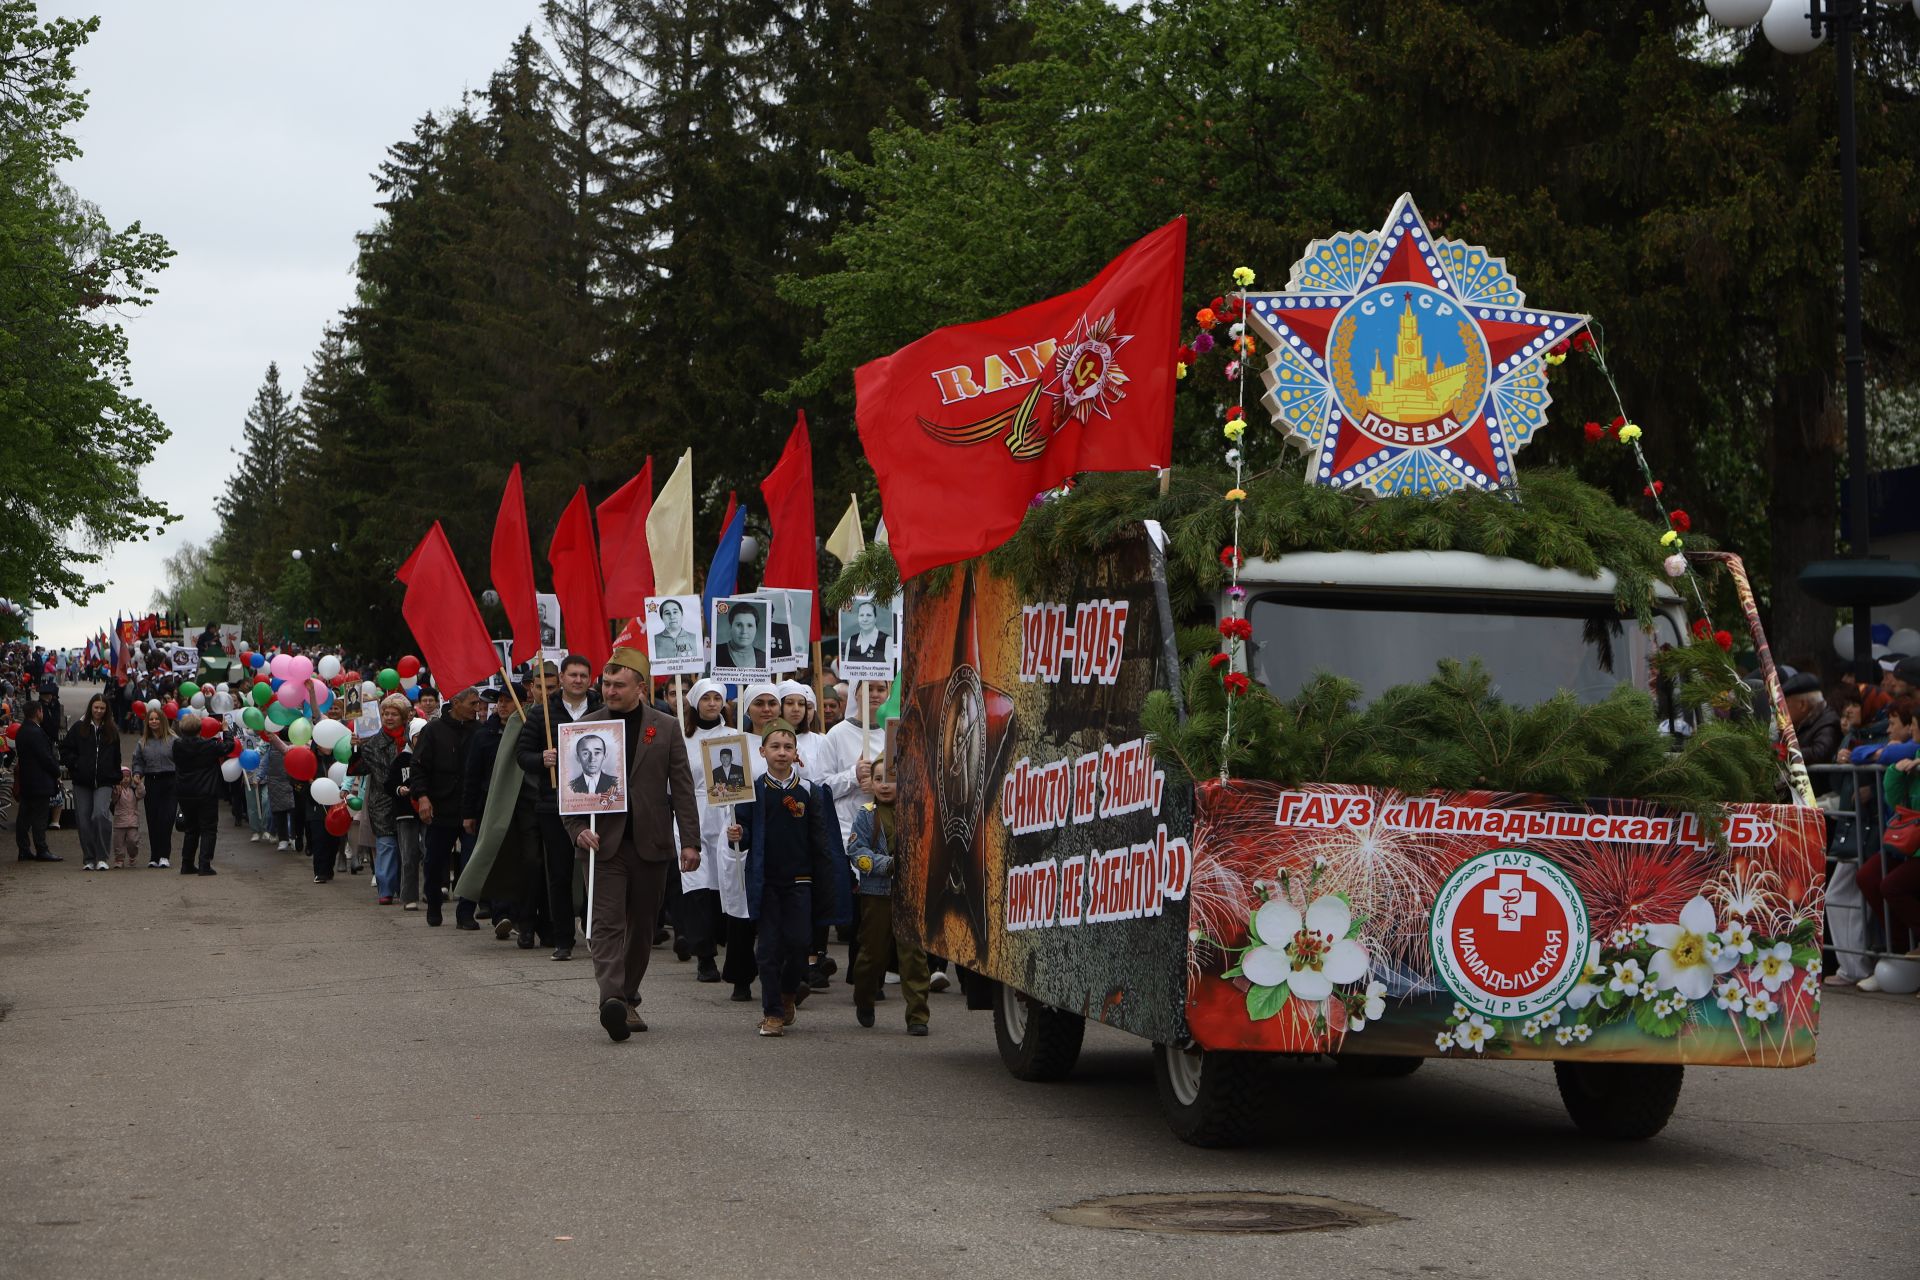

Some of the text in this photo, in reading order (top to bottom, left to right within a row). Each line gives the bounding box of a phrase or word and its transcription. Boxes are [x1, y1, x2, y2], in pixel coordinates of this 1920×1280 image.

[1360, 292, 1453, 317] СССР
[1361, 412, 1461, 443] ПОБЕДА
[1021, 602, 1128, 681] 1941-1945
[1075, 757, 1098, 818] НЕ
[1278, 795, 1372, 827] ГАУЗ
[1382, 801, 1671, 841] «Мамадышская
[1007, 832, 1187, 925] НИЧТО НЕ ЗАБЫТО!»
[1493, 853, 1532, 868] ГАУЗ
[1458, 927, 1563, 991] МАМАДЫШСКАЯ
